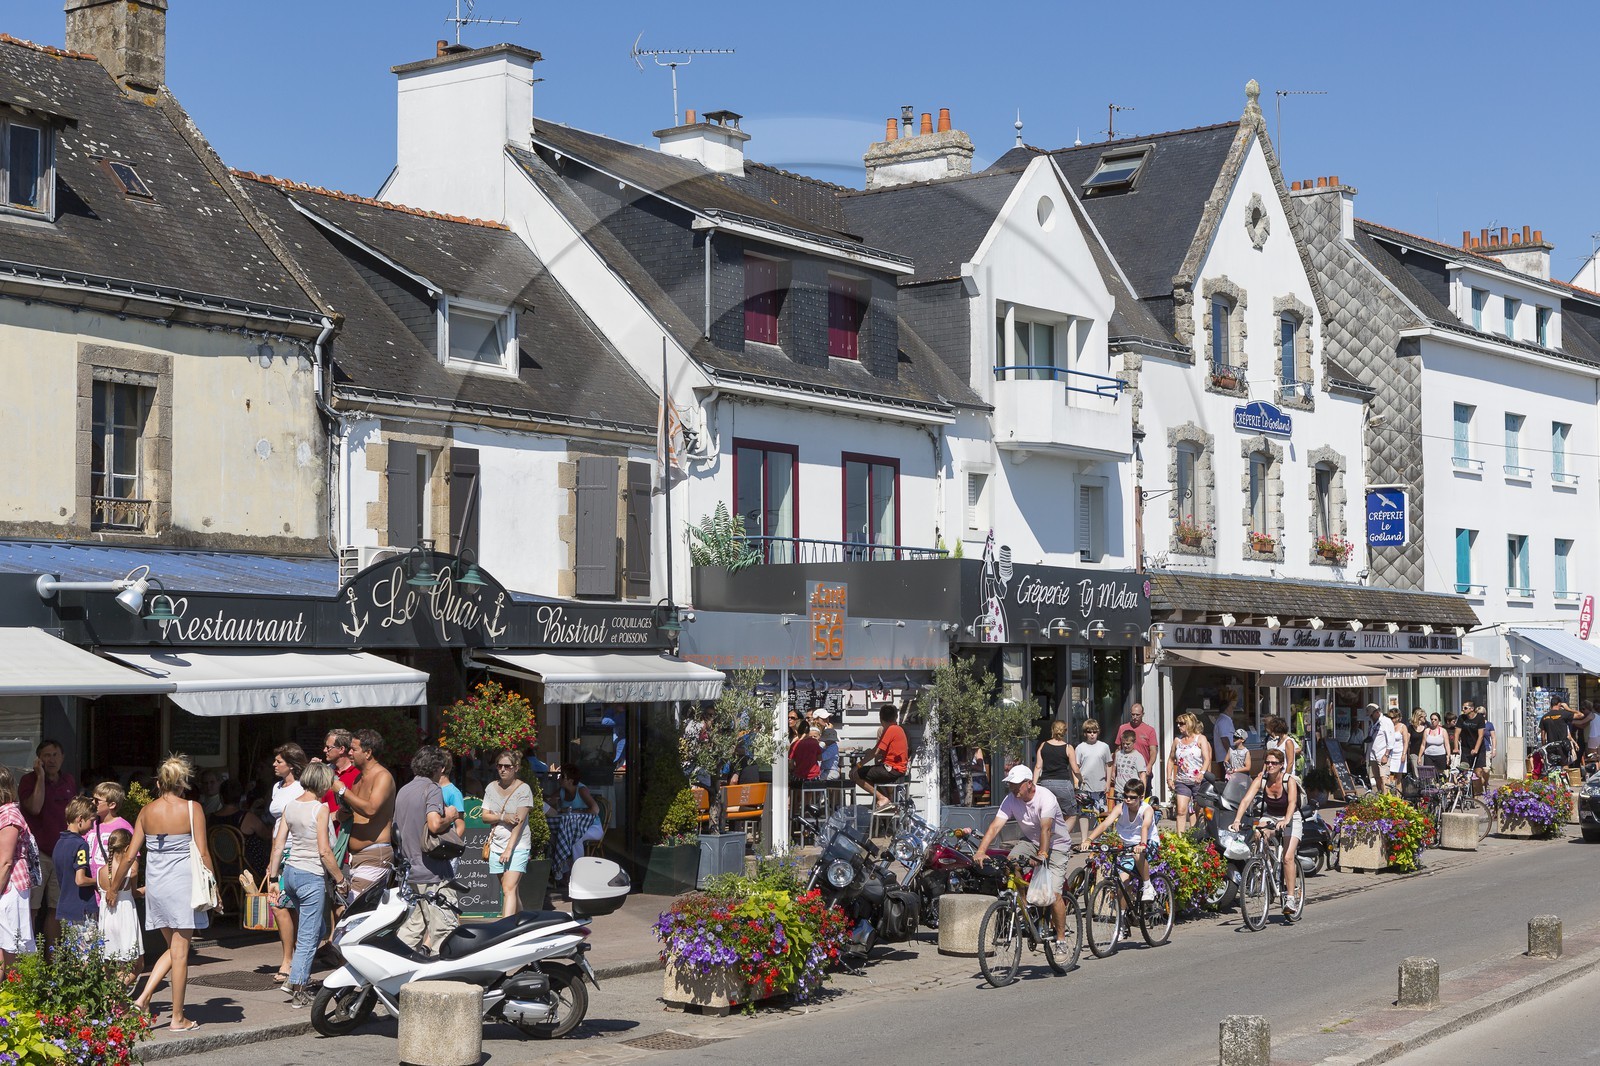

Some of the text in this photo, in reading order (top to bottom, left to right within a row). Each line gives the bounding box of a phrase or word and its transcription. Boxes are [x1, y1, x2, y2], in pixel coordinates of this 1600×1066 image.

[372, 565, 482, 642] Le Quai
[1016, 574, 1138, 618] Crêperie Ty Malou
[150, 595, 307, 643] Restaurant
[536, 605, 609, 645] Bistrot
[611, 617, 653, 629] COQUILLAGES
[1580, 596, 1593, 639] TABAC
[611, 633, 648, 644] et POISSONS
[815, 624, 843, 659] 56
[1174, 627, 1213, 644] GLACIER
[1220, 629, 1262, 645] PATISSIER
[1270, 628, 1289, 646] Aux
[1324, 632, 1335, 647] du
[1338, 631, 1357, 648] Quai
[1364, 634, 1399, 649] PIZZERIA
[1409, 635, 1429, 649] SALON
[1430, 636, 1439, 649] DE
[1402, 668, 1414, 678] THE
[1422, 666, 1481, 676] MAISON CHEVILLARD
[1283, 675, 1368, 687] MAISON CHEVILLARD
[286, 690, 326, 707] Le Quai
[77, 849, 87, 866] 3
